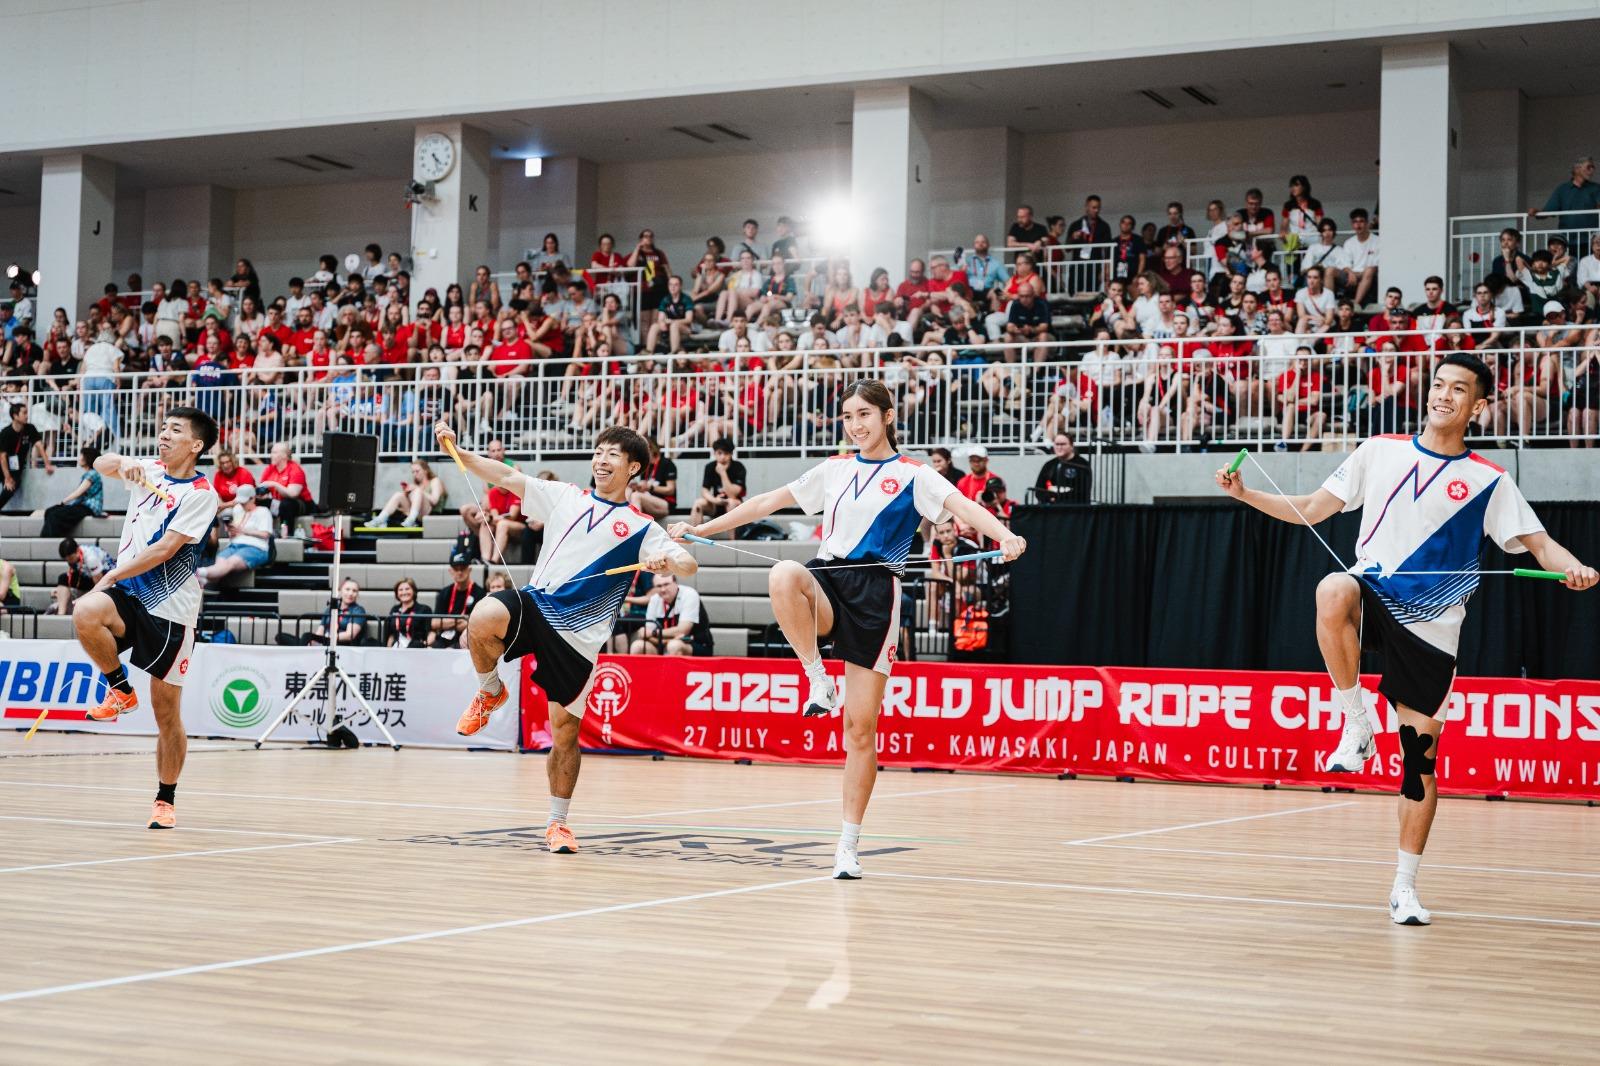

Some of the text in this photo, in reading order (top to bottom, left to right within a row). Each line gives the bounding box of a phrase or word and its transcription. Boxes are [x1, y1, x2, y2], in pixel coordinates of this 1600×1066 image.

[468, 195, 478, 212] K
[93, 220, 101, 236] J
[685, 671, 800, 713] 2025
[982, 676, 1103, 726] JUMP
[1117, 682, 1252, 729] ROPE
[684, 726, 707, 747] 27
[718, 727, 768, 748] JULY
[803, 730, 814, 751] 3
[950, 735, 1077, 761] KAWASAKI,
[1093, 740, 1167, 764] JAPAN
[1208, 745, 1298, 771] CULTTZ
